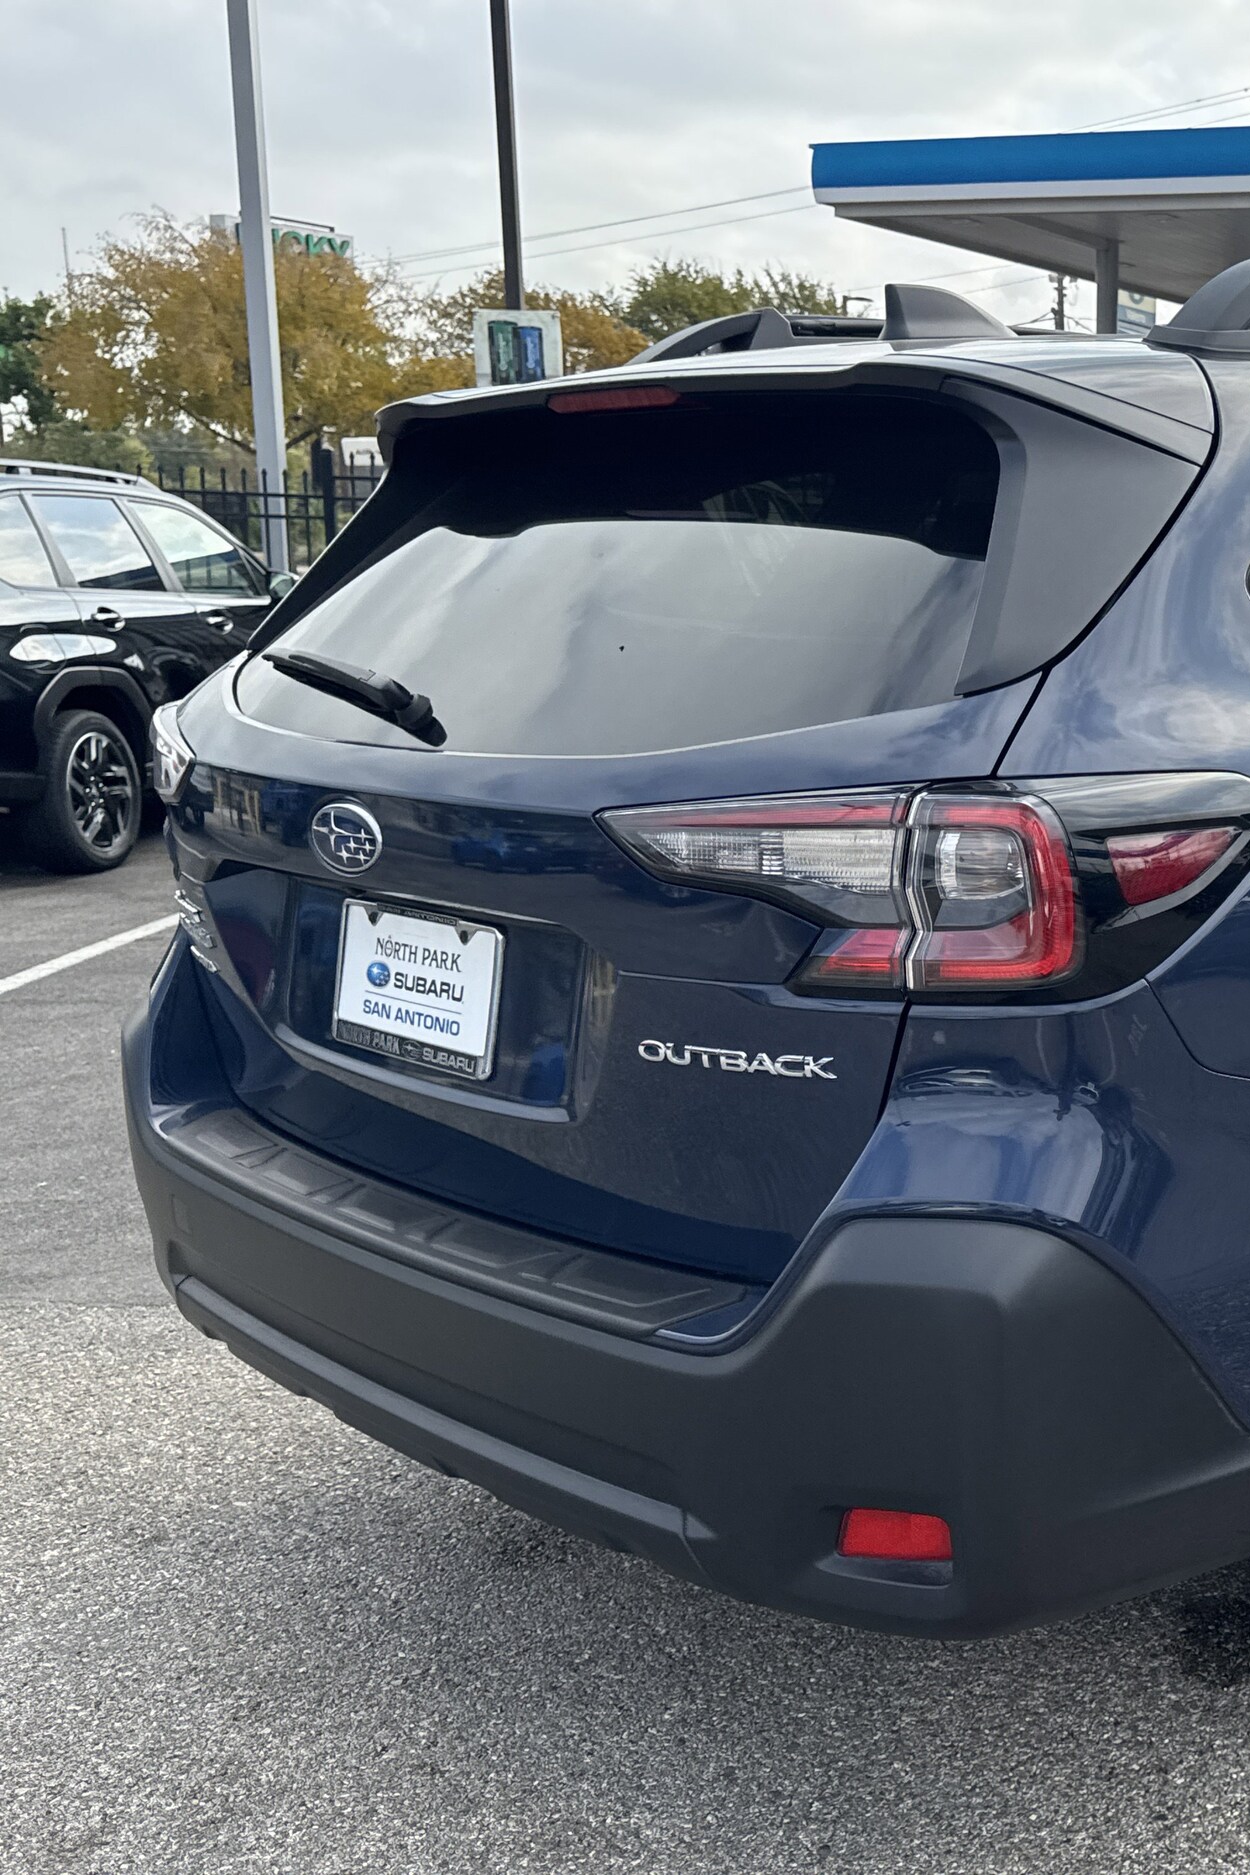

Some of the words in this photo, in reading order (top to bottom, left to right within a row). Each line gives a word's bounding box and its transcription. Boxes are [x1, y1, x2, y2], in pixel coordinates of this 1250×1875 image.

[374, 935, 418, 964] NORTH
[421, 947, 463, 973] PARK
[393, 971, 464, 1003] SUBARU
[362, 999, 391, 1020] SAN
[394, 1007, 461, 1037] ANTONIO
[373, 1031, 400, 1055] PARK
[421, 1047, 476, 1073] SUBARU
[637, 1039, 838, 1079] OUTBACK
